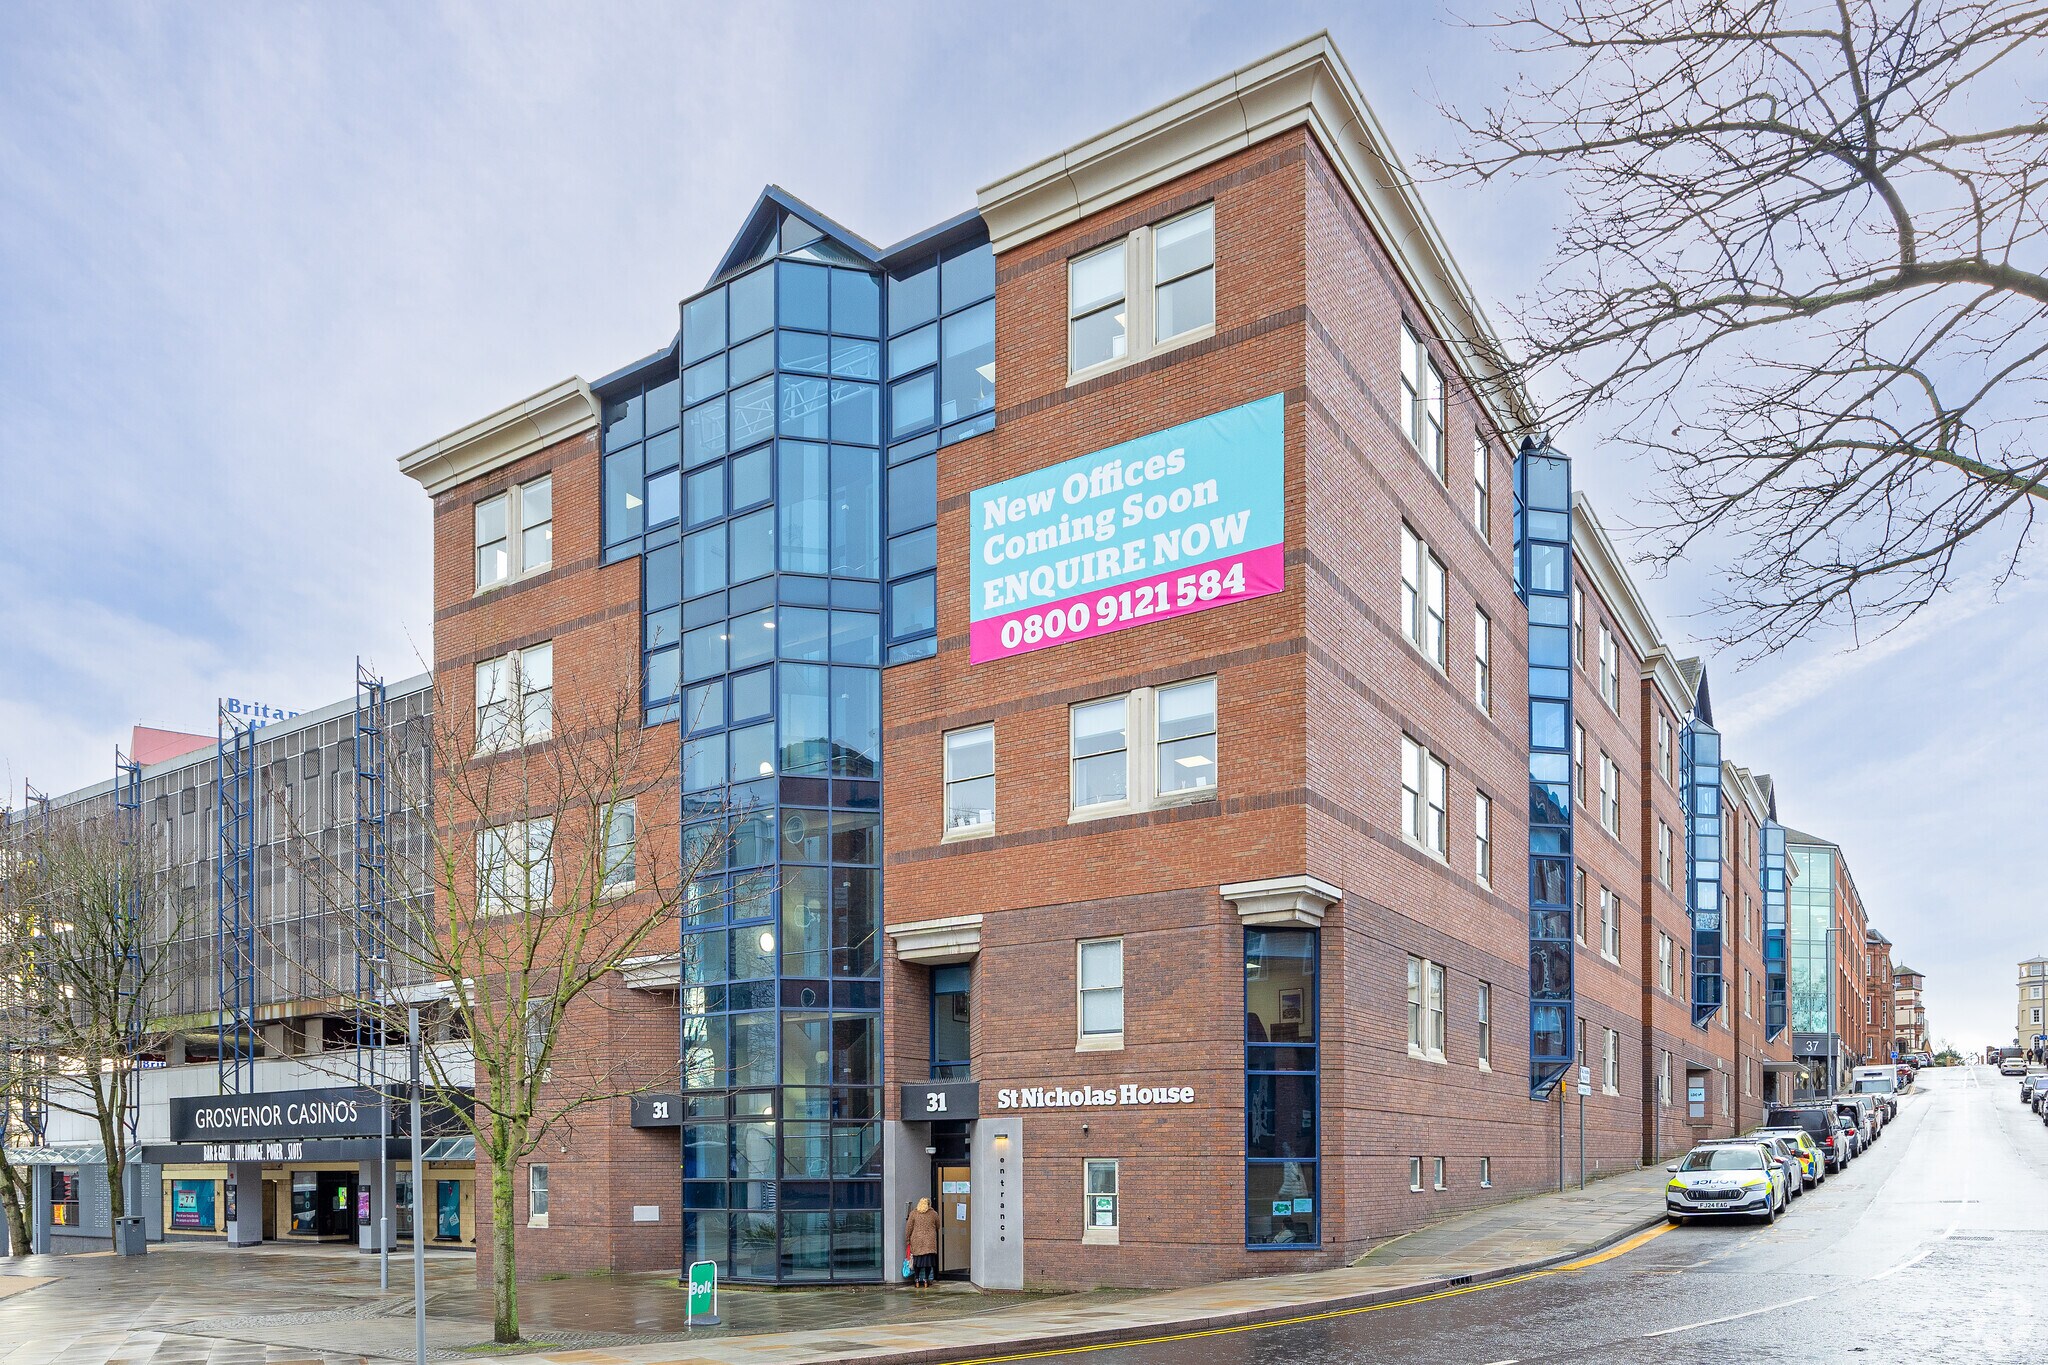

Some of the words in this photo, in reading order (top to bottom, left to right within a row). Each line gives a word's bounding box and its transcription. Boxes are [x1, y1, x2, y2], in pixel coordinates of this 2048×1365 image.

[983, 487, 1056, 531] New
[1062, 447, 1186, 505] Offices
[983, 509, 1116, 565] Coming
[1122, 478, 1219, 527] Soon
[983, 538, 1146, 610] ENQUIRE
[1153, 510, 1251, 566] NOW
[1001, 602, 1090, 649] 0800
[1097, 582, 1171, 627] 9121
[1178, 562, 1246, 608] 584
[1806, 1041, 1819, 1051] 37
[926, 1092, 948, 1112] 31
[998, 1089, 1019, 1109] St
[1021, 1086, 1117, 1107] Nicholas
[1119, 1084, 1195, 1105] House
[195, 1104, 282, 1129] GROSVENOR
[287, 1100, 358, 1125] CASINOS
[652, 1101, 669, 1119] 31
[287, 1142, 303, 1160] SLOTS
[690, 1280, 711, 1297] Bolt
